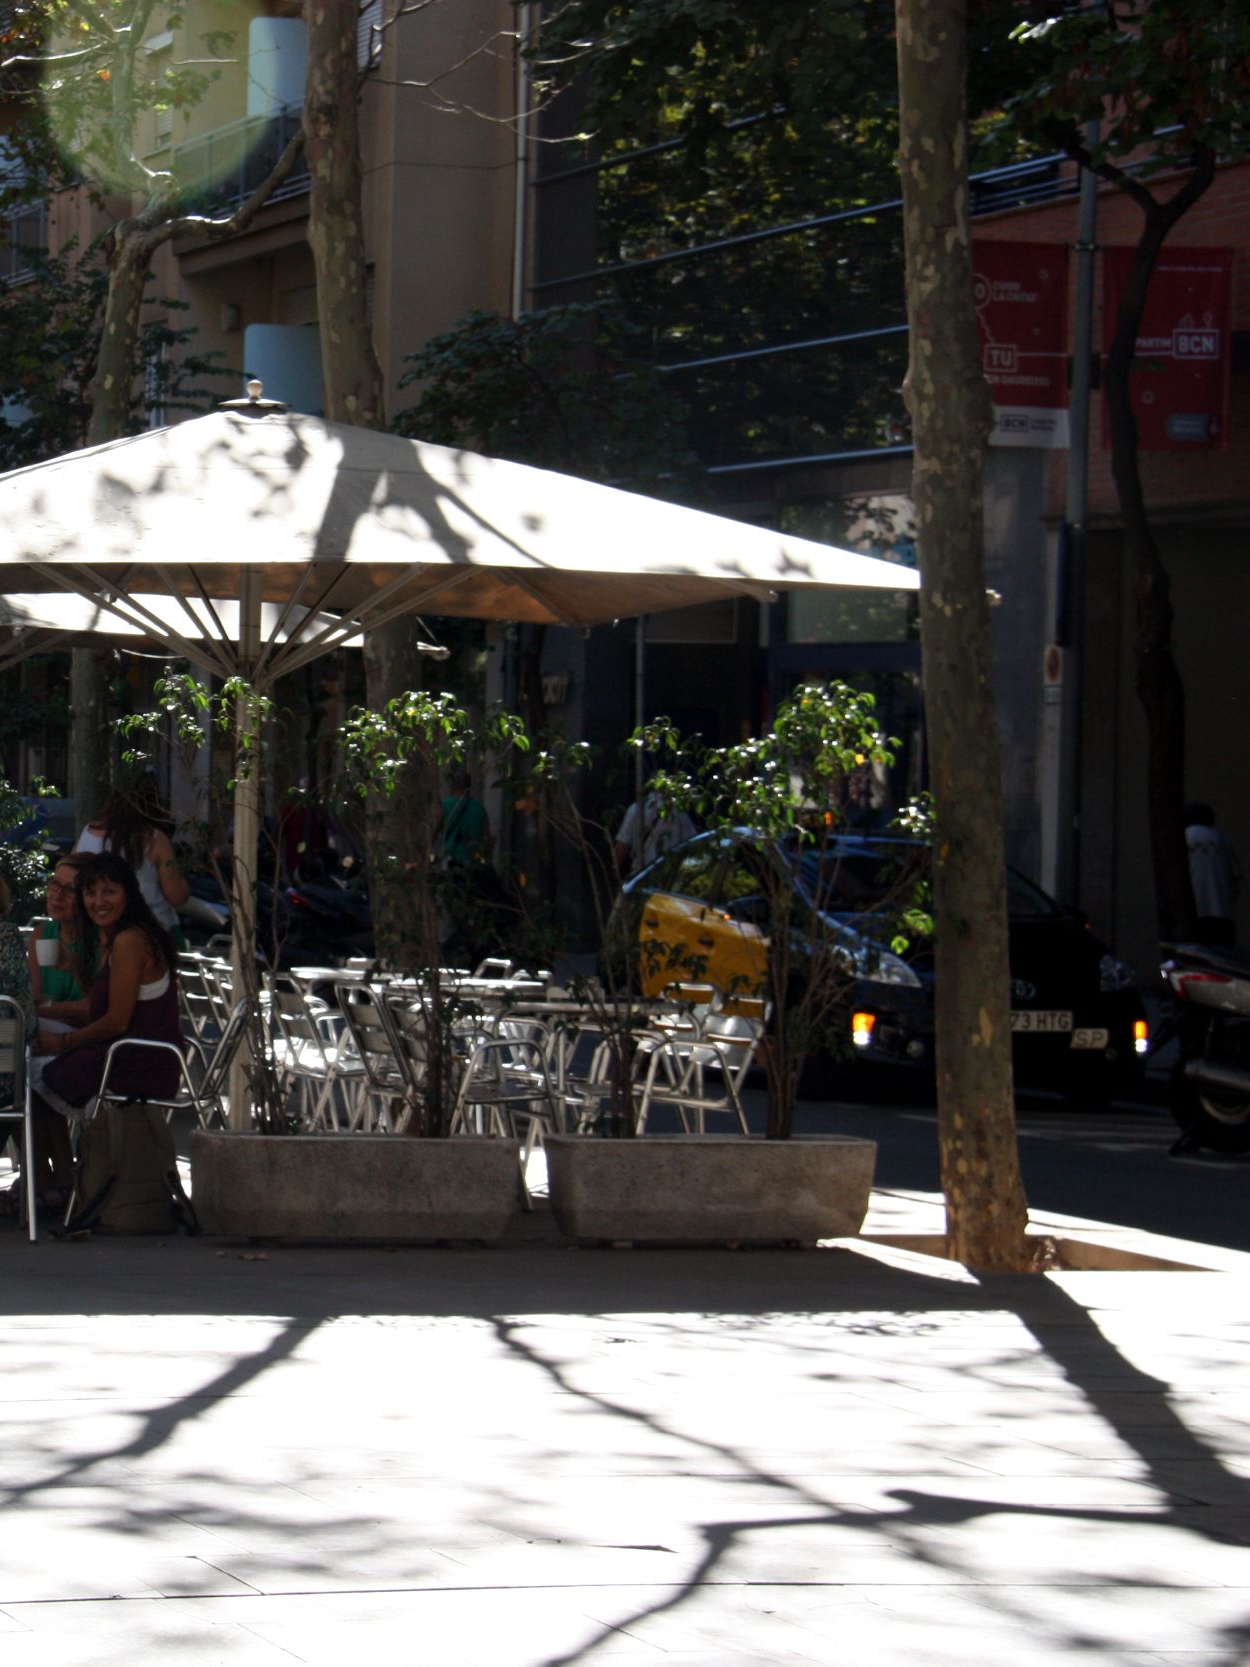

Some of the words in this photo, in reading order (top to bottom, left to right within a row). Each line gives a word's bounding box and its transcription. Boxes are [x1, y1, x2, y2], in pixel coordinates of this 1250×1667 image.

[974, 283, 986, 299] O
[1135, 337, 1171, 349] PARTIM
[1178, 336, 1214, 353] BCN
[989, 350, 1012, 367] TU
[1010, 1013, 1031, 1028] 73
[1076, 1031, 1103, 1046] SP
